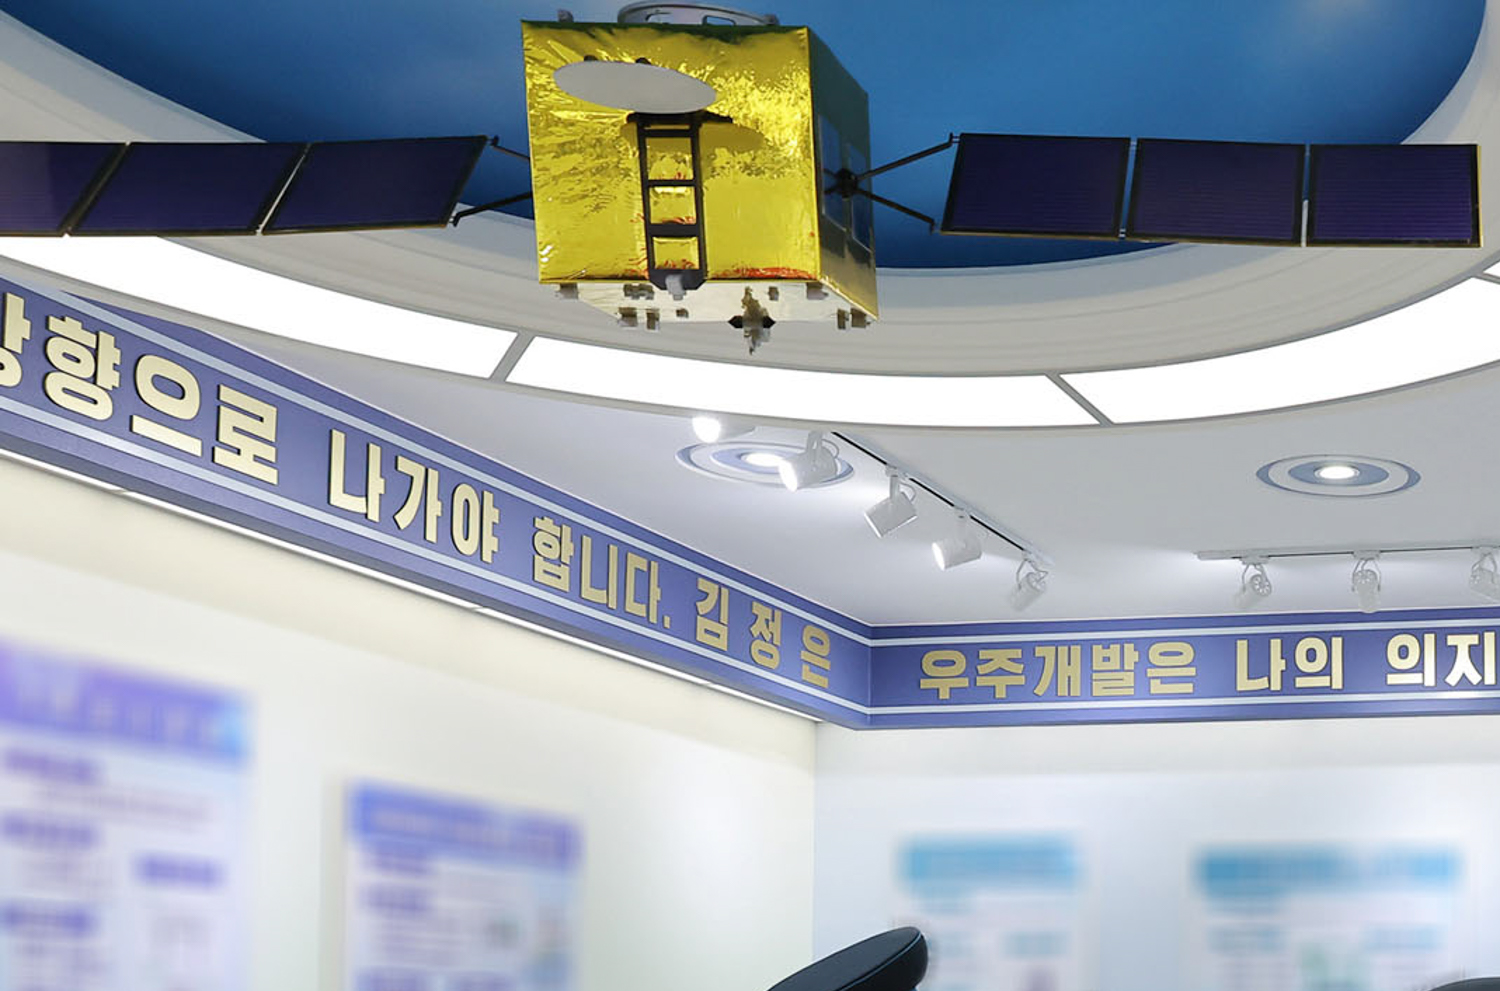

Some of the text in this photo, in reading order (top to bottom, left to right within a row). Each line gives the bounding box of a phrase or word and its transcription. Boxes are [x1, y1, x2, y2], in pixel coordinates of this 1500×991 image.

[328, 427, 500, 565] 나가야
[532, 515, 671, 629] 합니다.
[695, 577, 730, 652] 김
[749, 601, 782, 671] 정
[800, 624, 832, 688] 은
[918, 640, 1198, 700] 우주개발은
[1235, 635, 1345, 692] 나의
